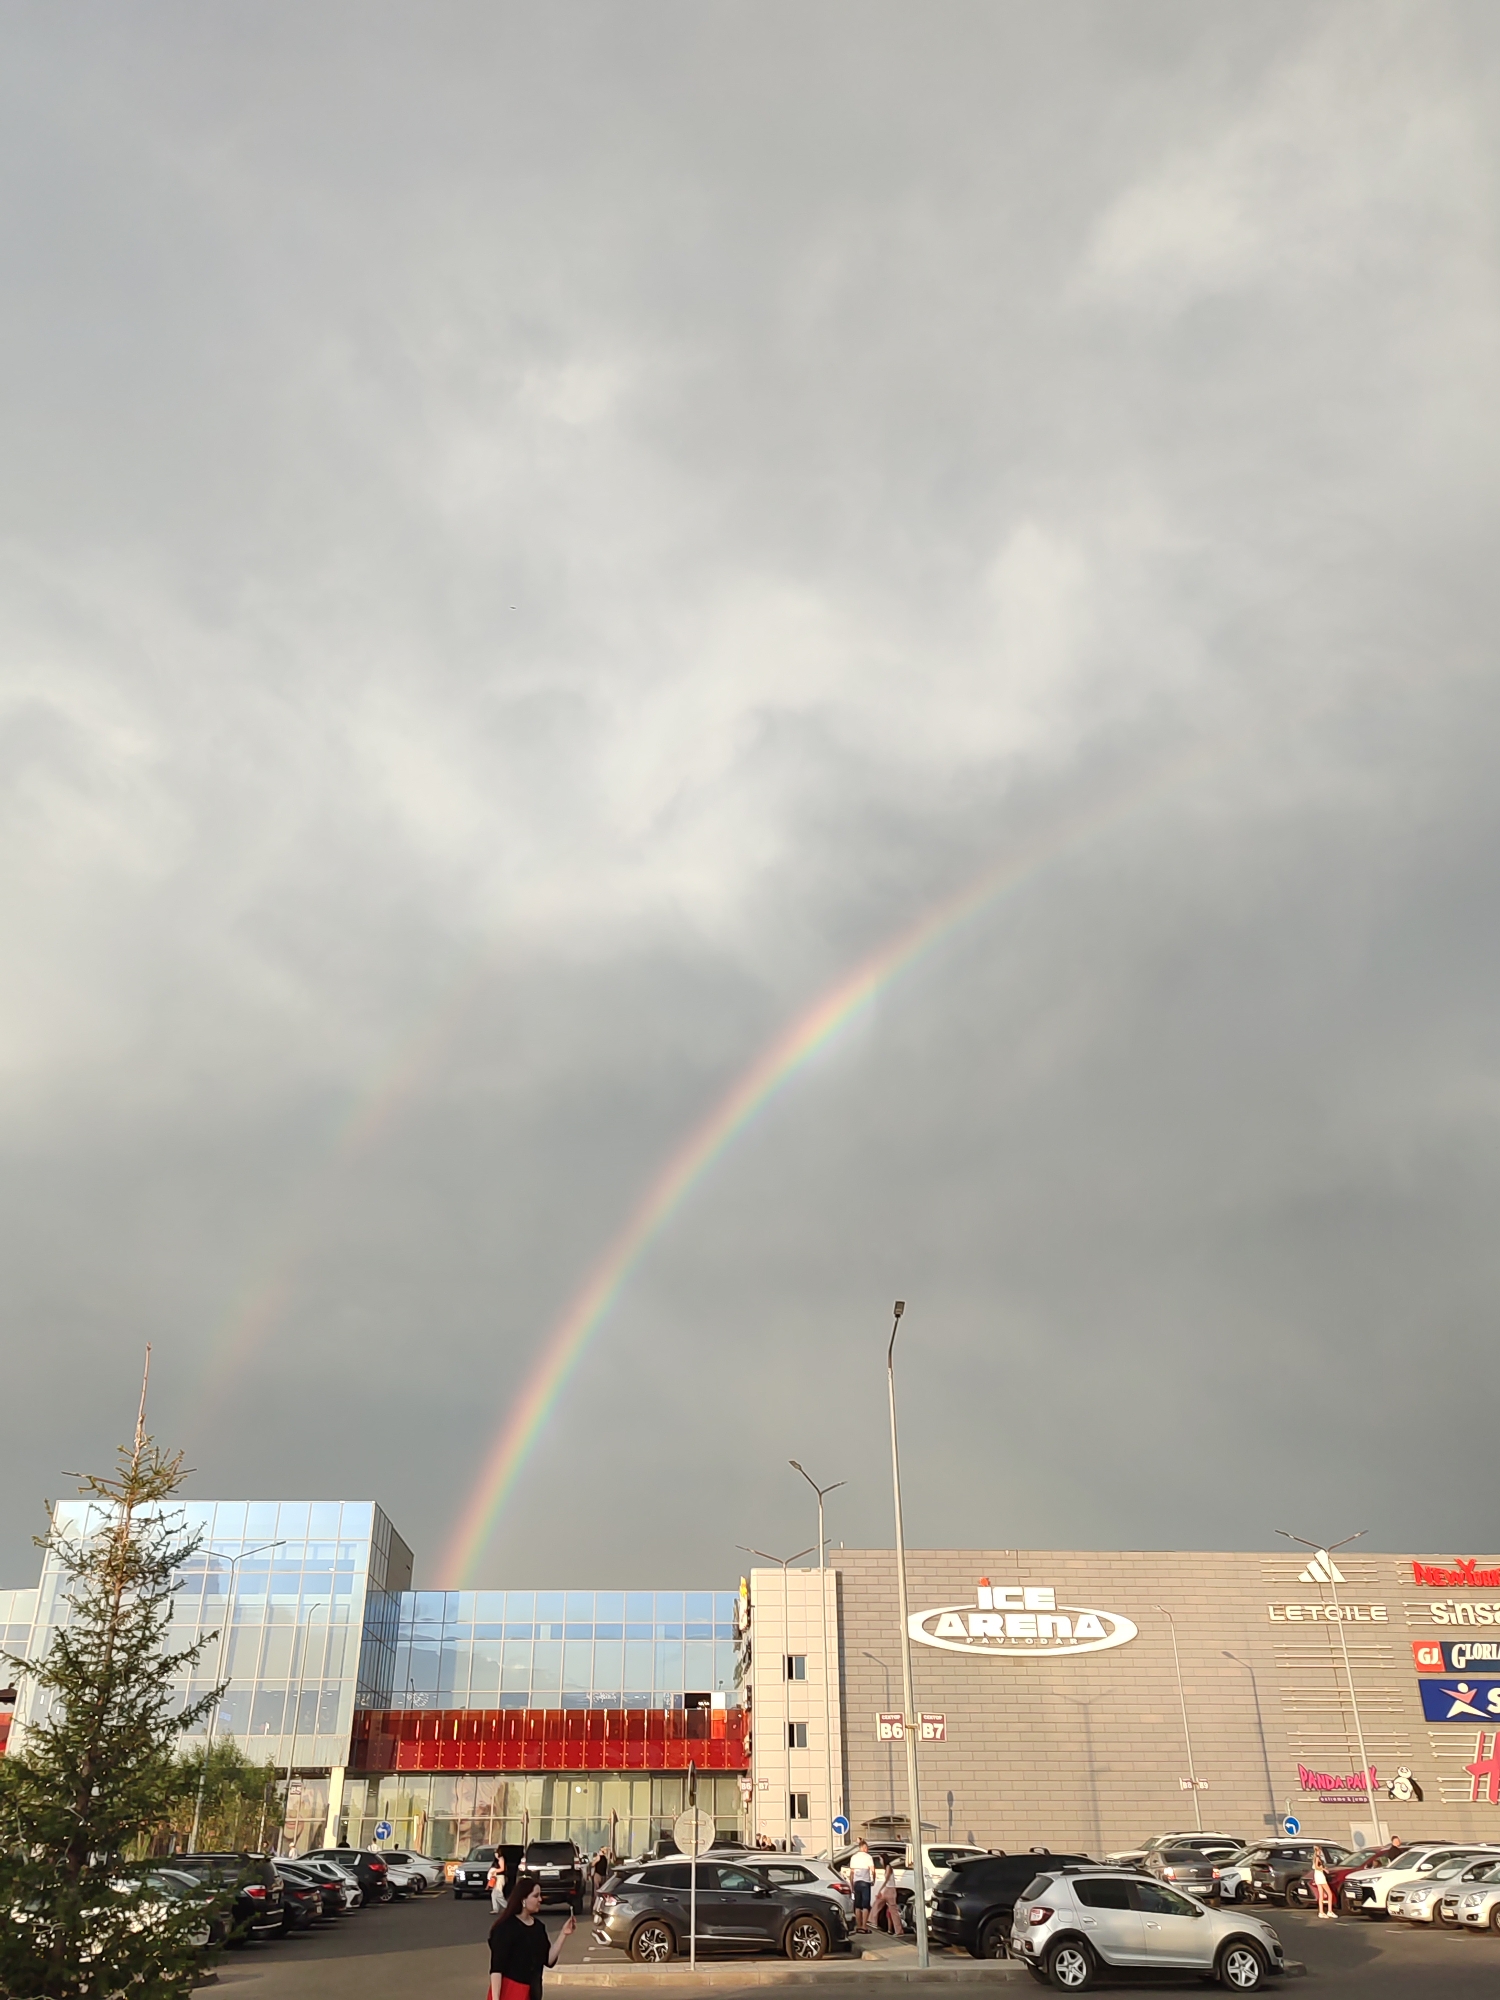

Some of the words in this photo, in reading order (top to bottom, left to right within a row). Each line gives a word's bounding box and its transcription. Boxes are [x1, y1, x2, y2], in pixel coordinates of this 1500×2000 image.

[966, 1637, 1079, 1645] PAVLODAR
[1451, 1643, 1500, 1669] GLORI
[1298, 1763, 1346, 1791] PANDA
